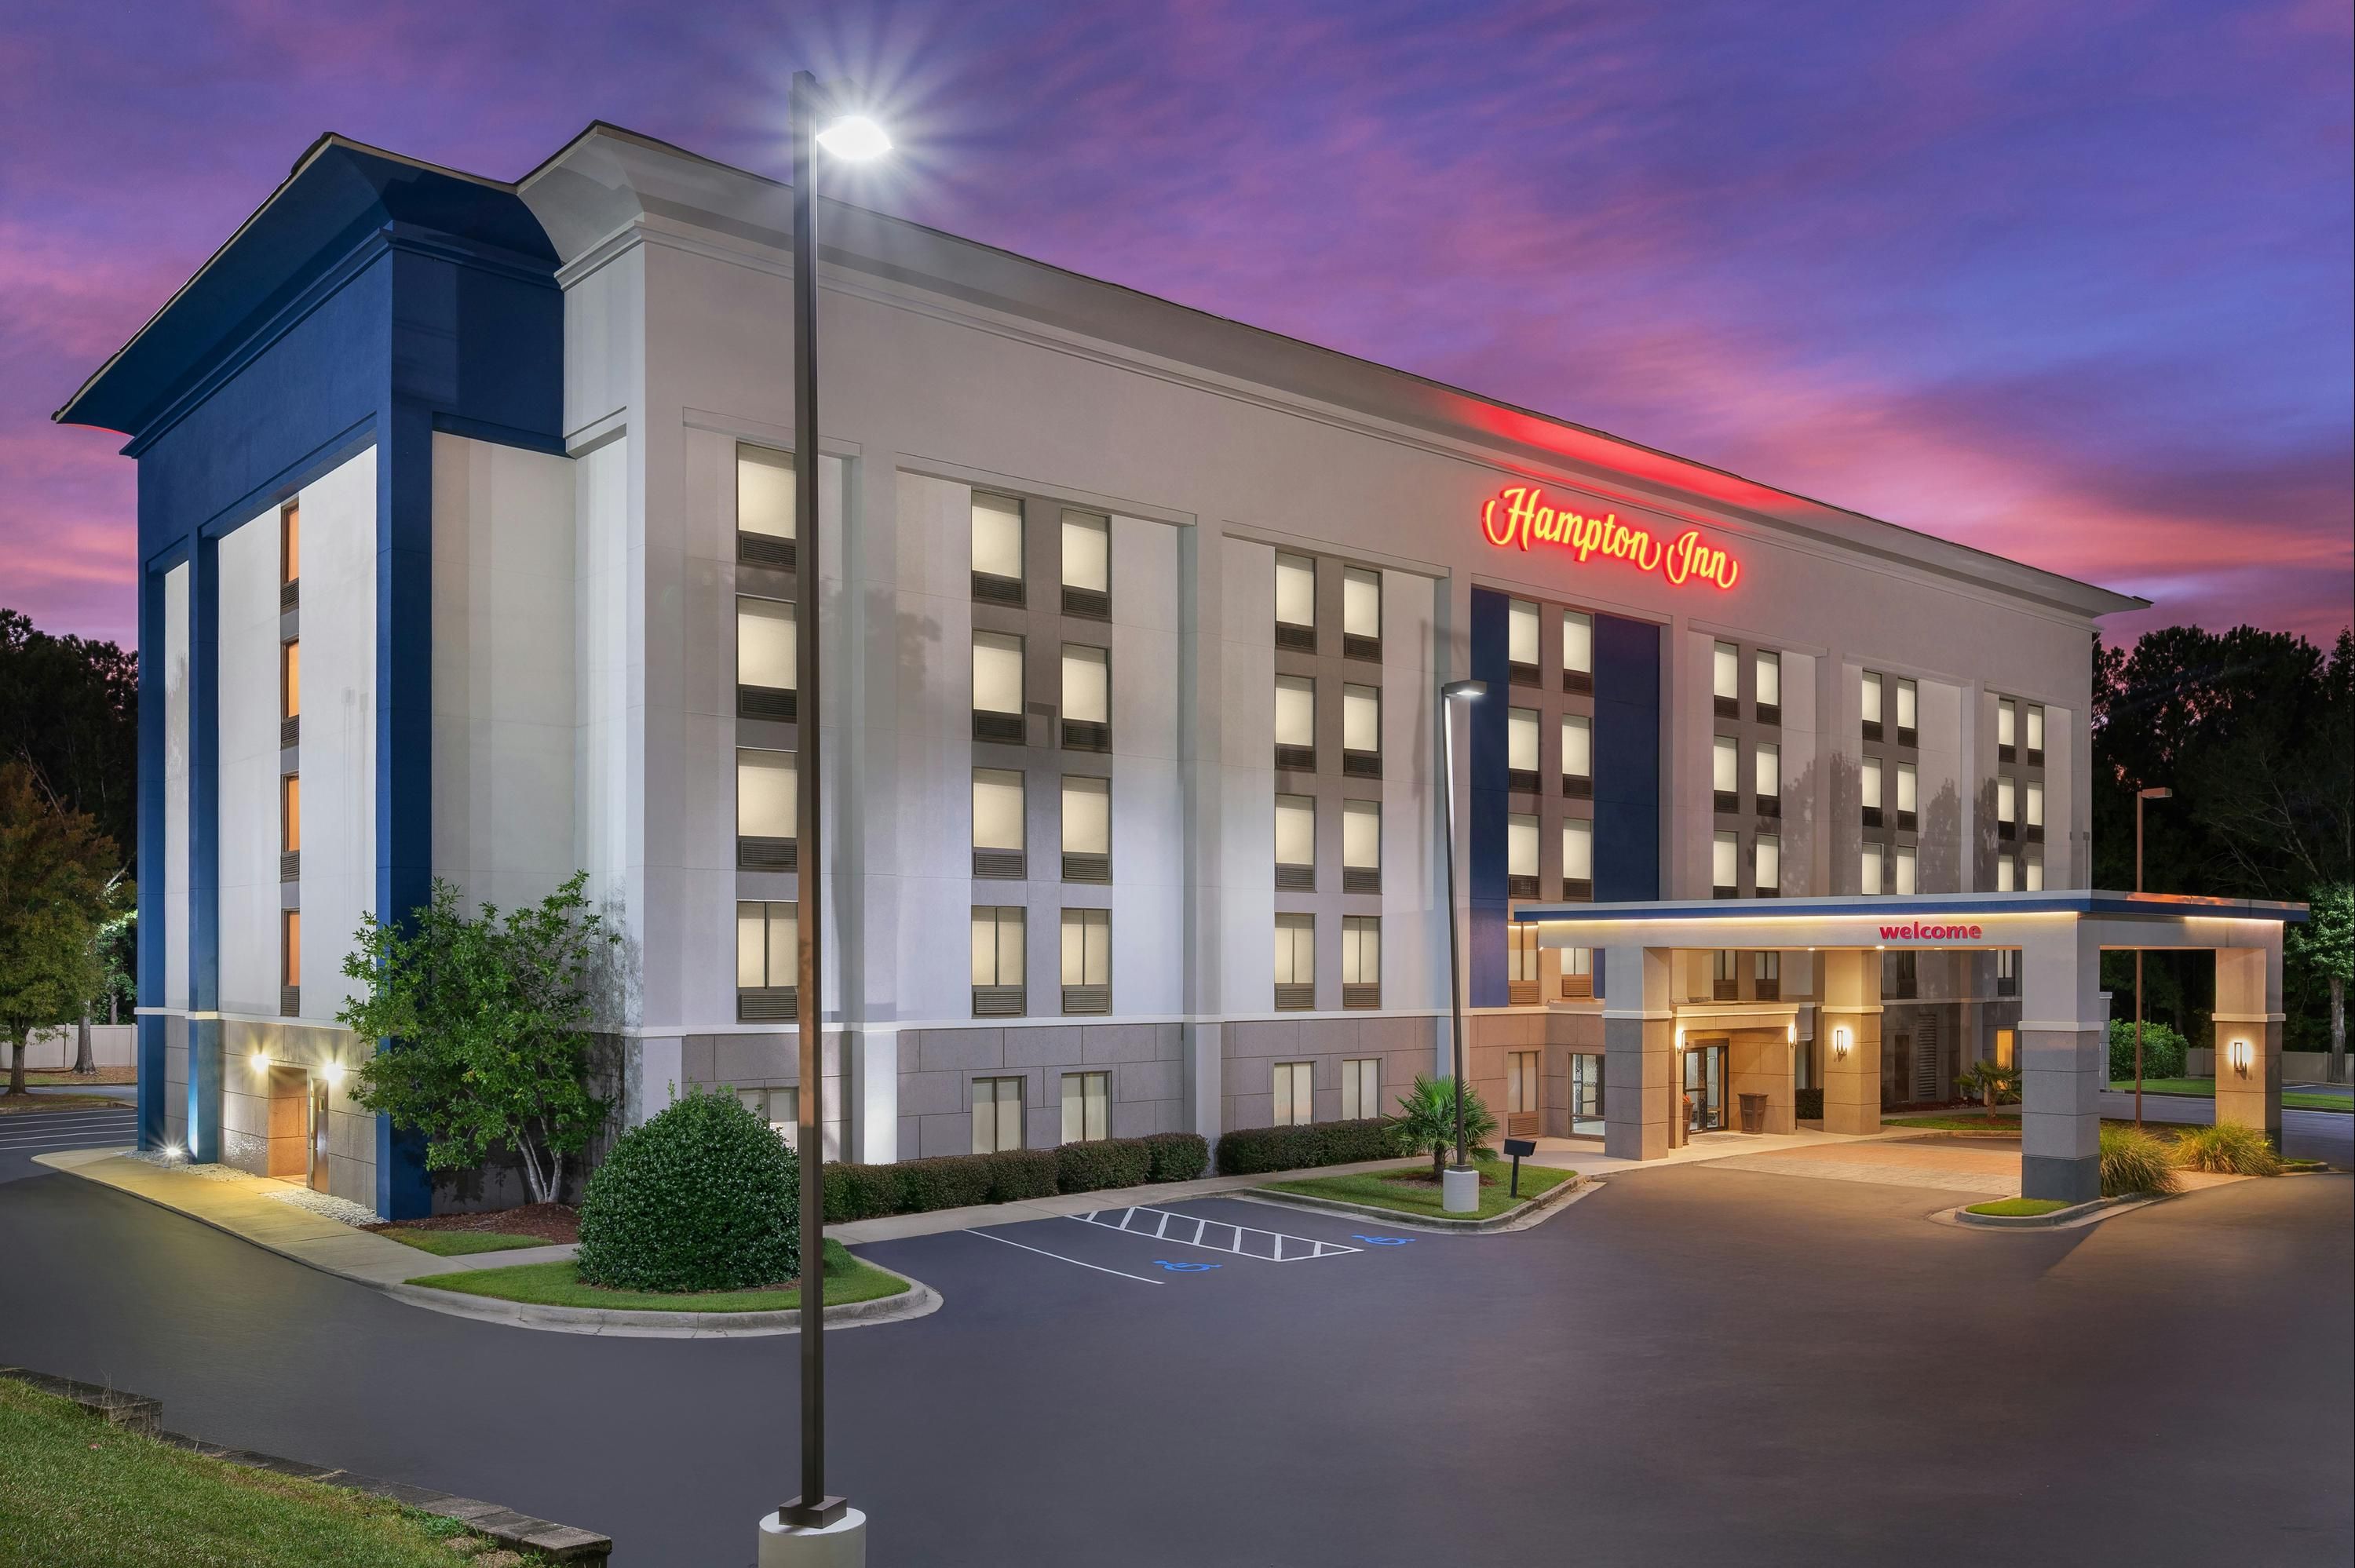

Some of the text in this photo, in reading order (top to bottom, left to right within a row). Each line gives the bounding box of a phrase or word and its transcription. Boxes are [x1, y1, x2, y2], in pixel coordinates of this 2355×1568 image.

[1482, 487, 1739, 589] Hampton Inn
[1879, 921, 1982, 939] welcome
